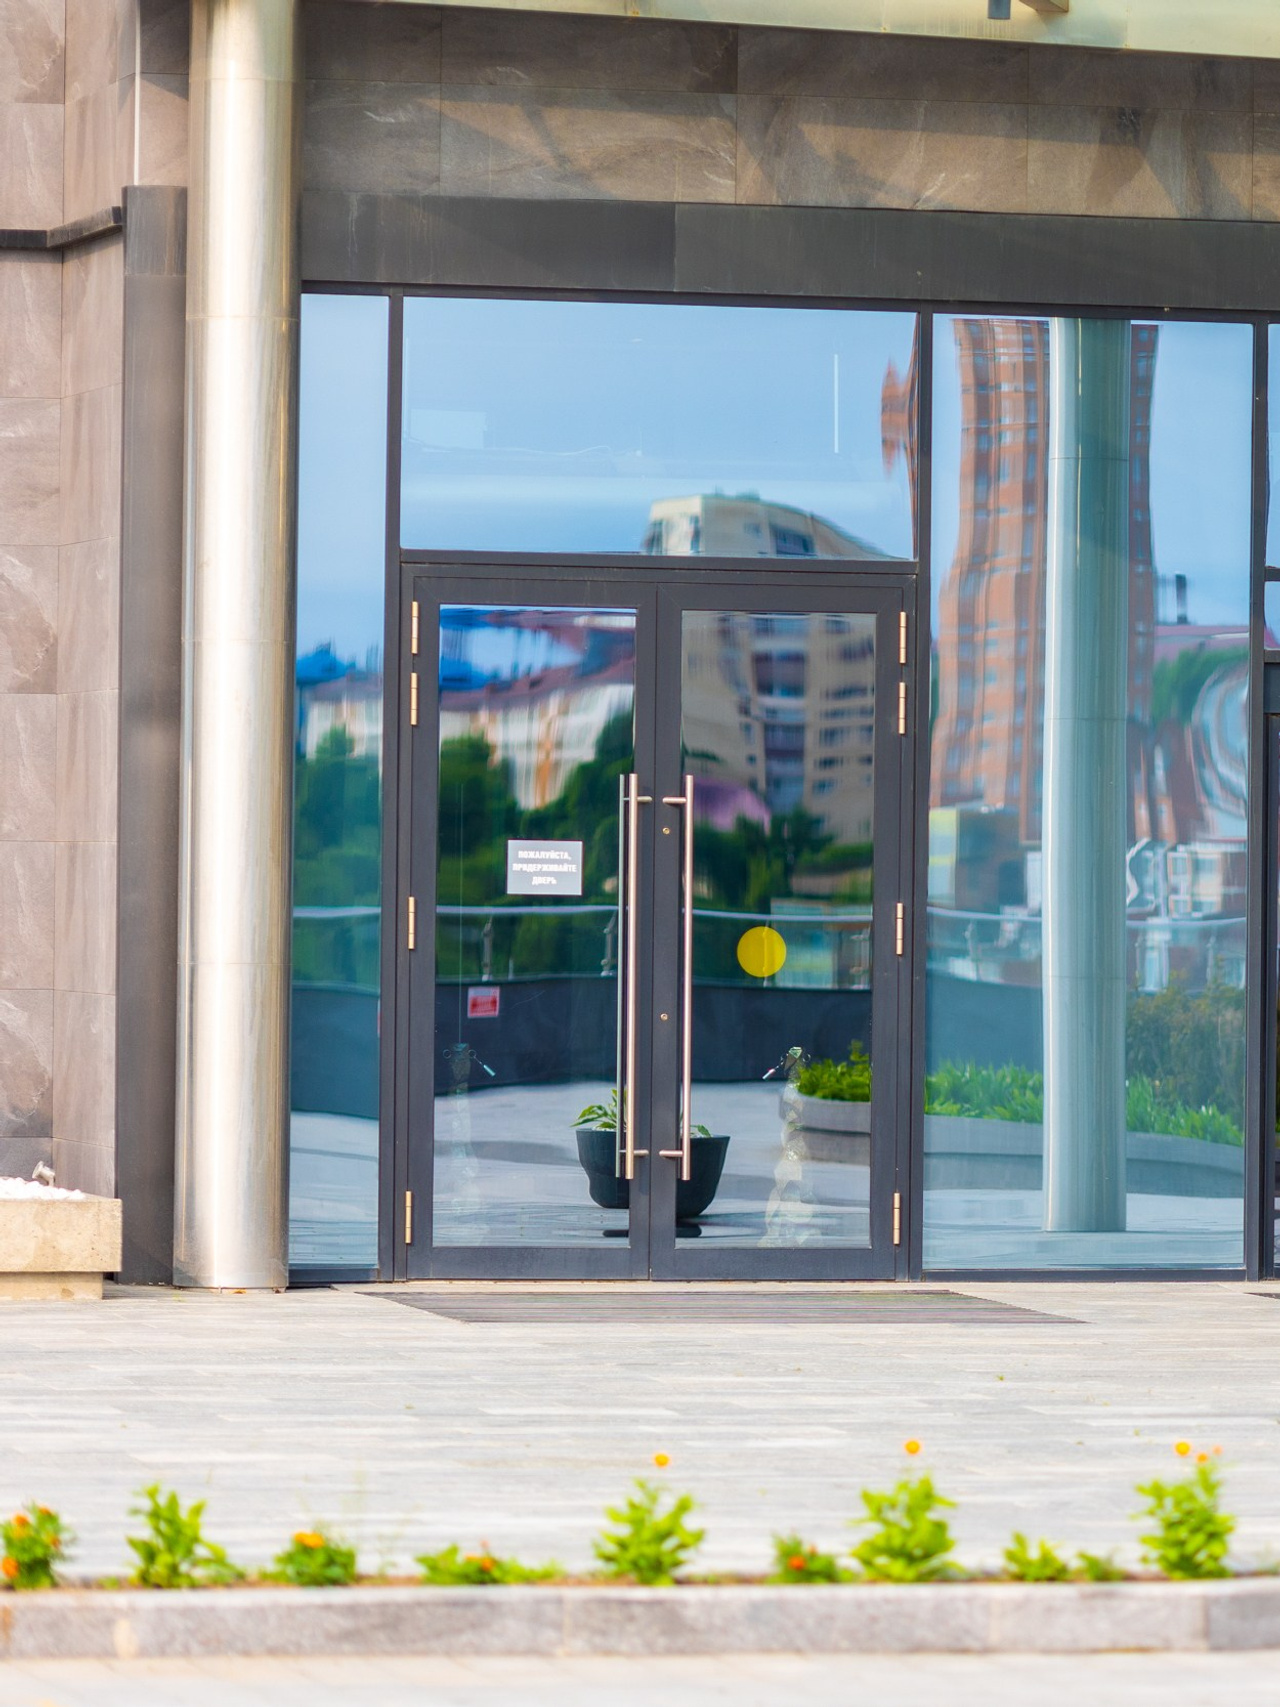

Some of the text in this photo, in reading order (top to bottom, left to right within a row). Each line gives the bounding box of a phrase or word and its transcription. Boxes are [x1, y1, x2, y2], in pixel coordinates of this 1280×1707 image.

[517, 850, 572, 860] ПОЖАЛУЙСТА,
[512, 863, 578, 873] ПРИДЕРЖИВАЙТЕ
[531, 876, 558, 886] ДВЕРЬ
